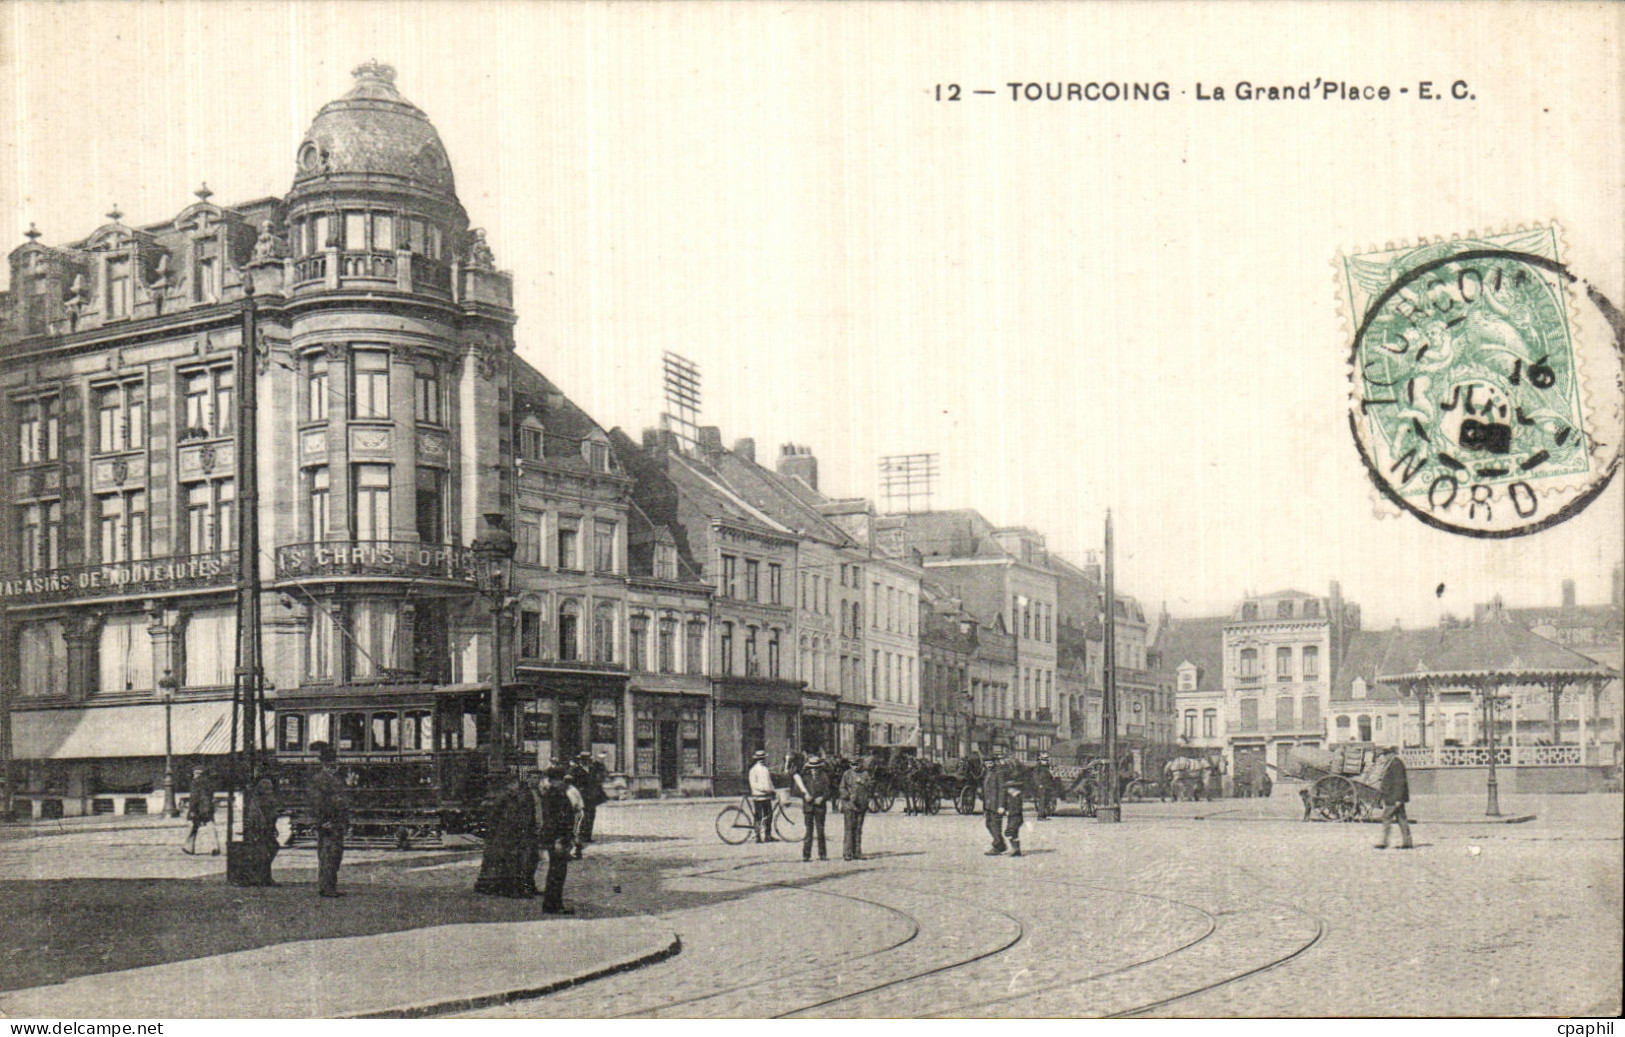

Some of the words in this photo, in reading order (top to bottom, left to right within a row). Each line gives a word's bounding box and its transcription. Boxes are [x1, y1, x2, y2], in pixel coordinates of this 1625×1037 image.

[936, 84, 961, 101] 12
[1007, 82, 1170, 101] TOURCOING
[1196, 83, 1225, 101] La
[1235, 77, 1390, 101] Grand'Place
[1419, 81, 1442, 100] E.
[1451, 80, 1476, 100] C.
[1390, 447, 1538, 522] NORD
[79, 571, 102, 589] DE
